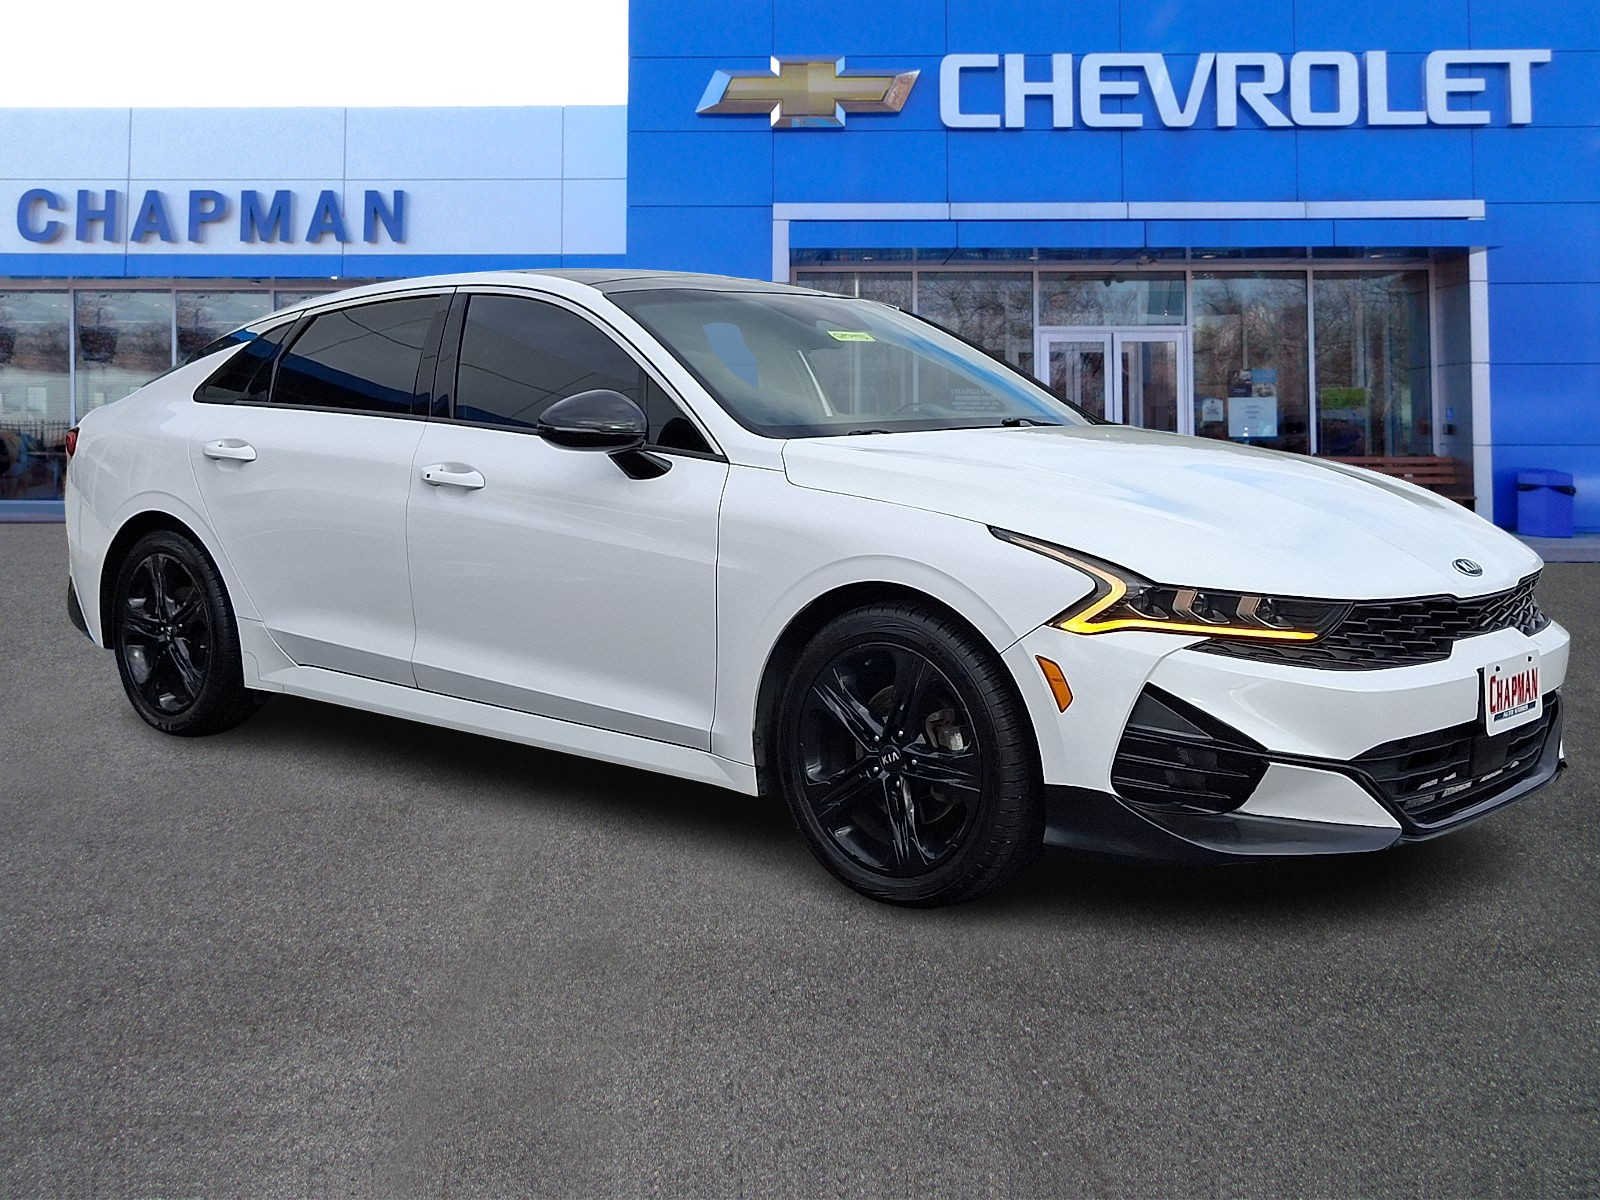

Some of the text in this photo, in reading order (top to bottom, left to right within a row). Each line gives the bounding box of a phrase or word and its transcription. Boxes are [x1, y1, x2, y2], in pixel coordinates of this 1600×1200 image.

[939, 49, 1552, 129] CHEVROLET
[16, 188, 409, 243] CHAPMAN
[1489, 667, 1538, 714] CHAPMAN
[881, 751, 900, 766] KIA
